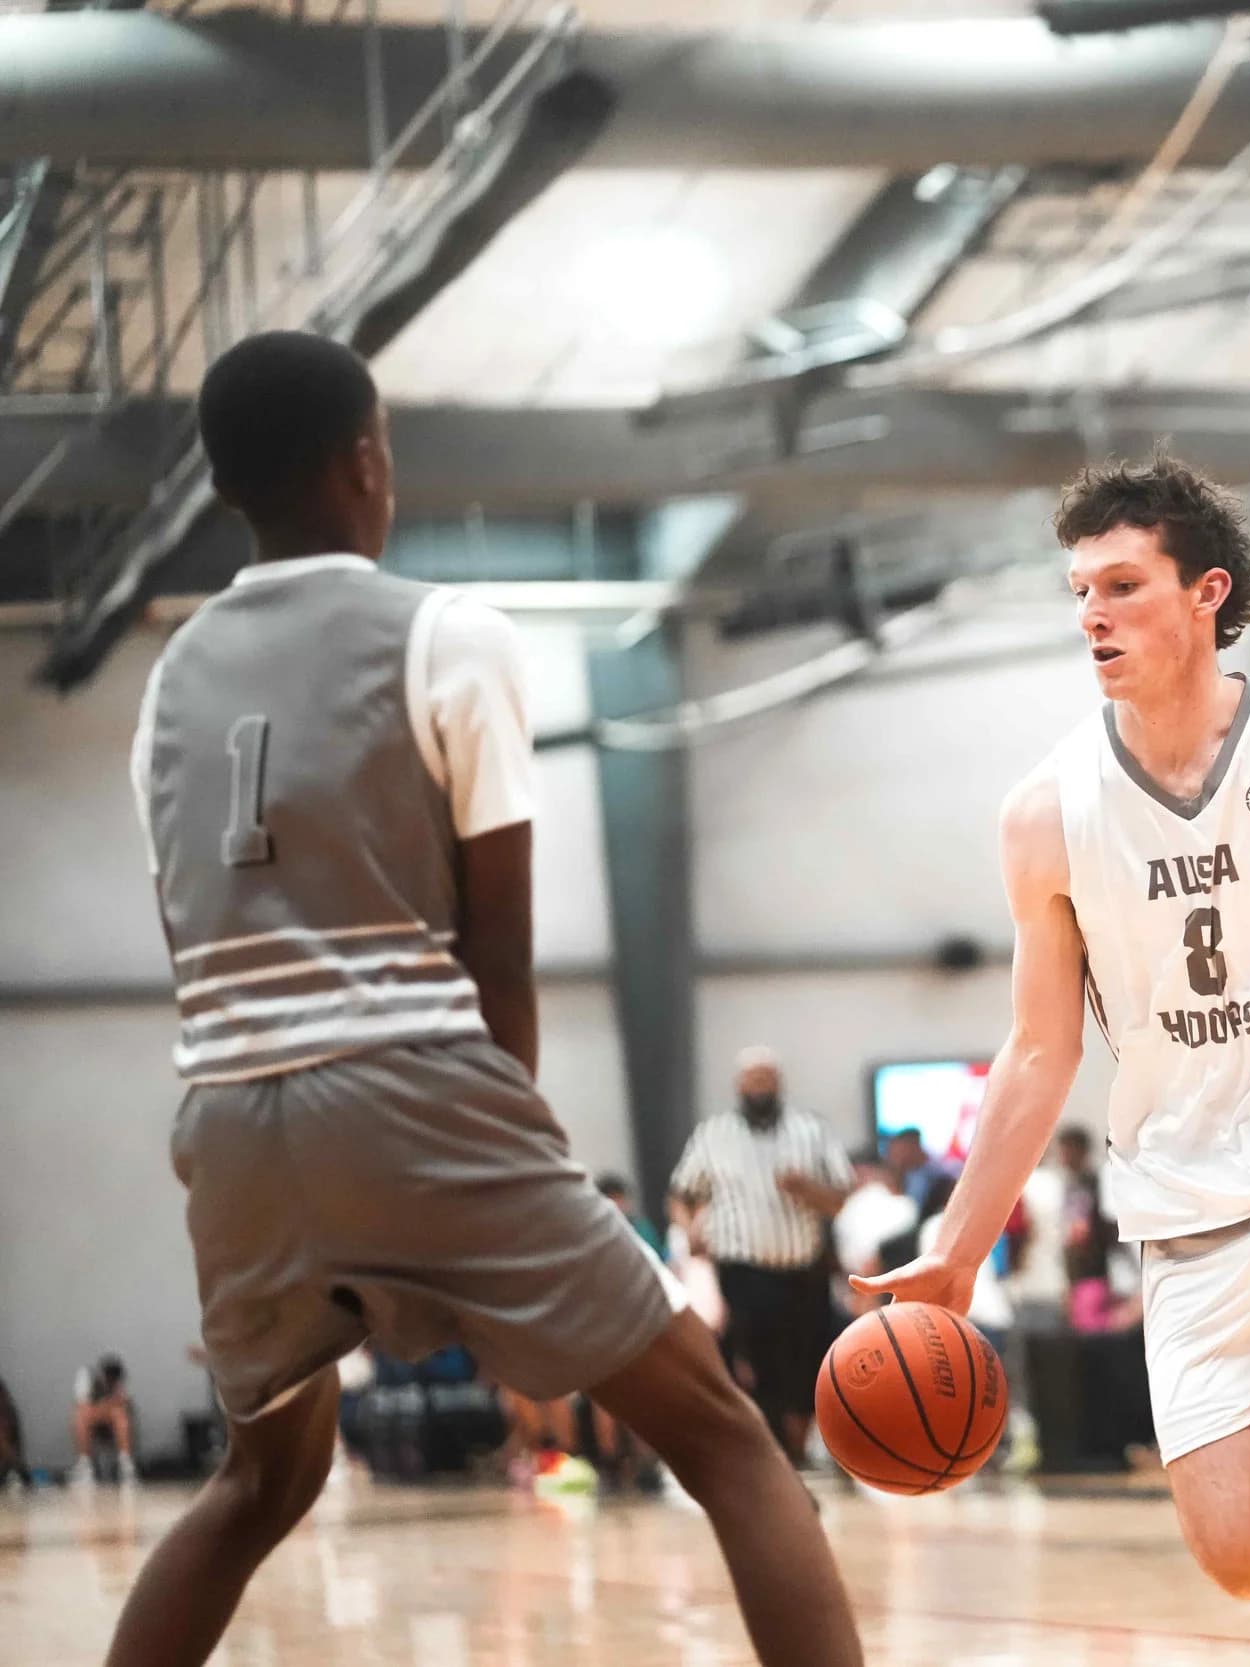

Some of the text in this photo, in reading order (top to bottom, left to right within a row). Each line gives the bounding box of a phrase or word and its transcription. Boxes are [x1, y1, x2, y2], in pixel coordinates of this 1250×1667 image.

[221, 714, 276, 869] 1
[1147, 843, 1240, 901] AUSA
[1183, 906, 1228, 996] 8
